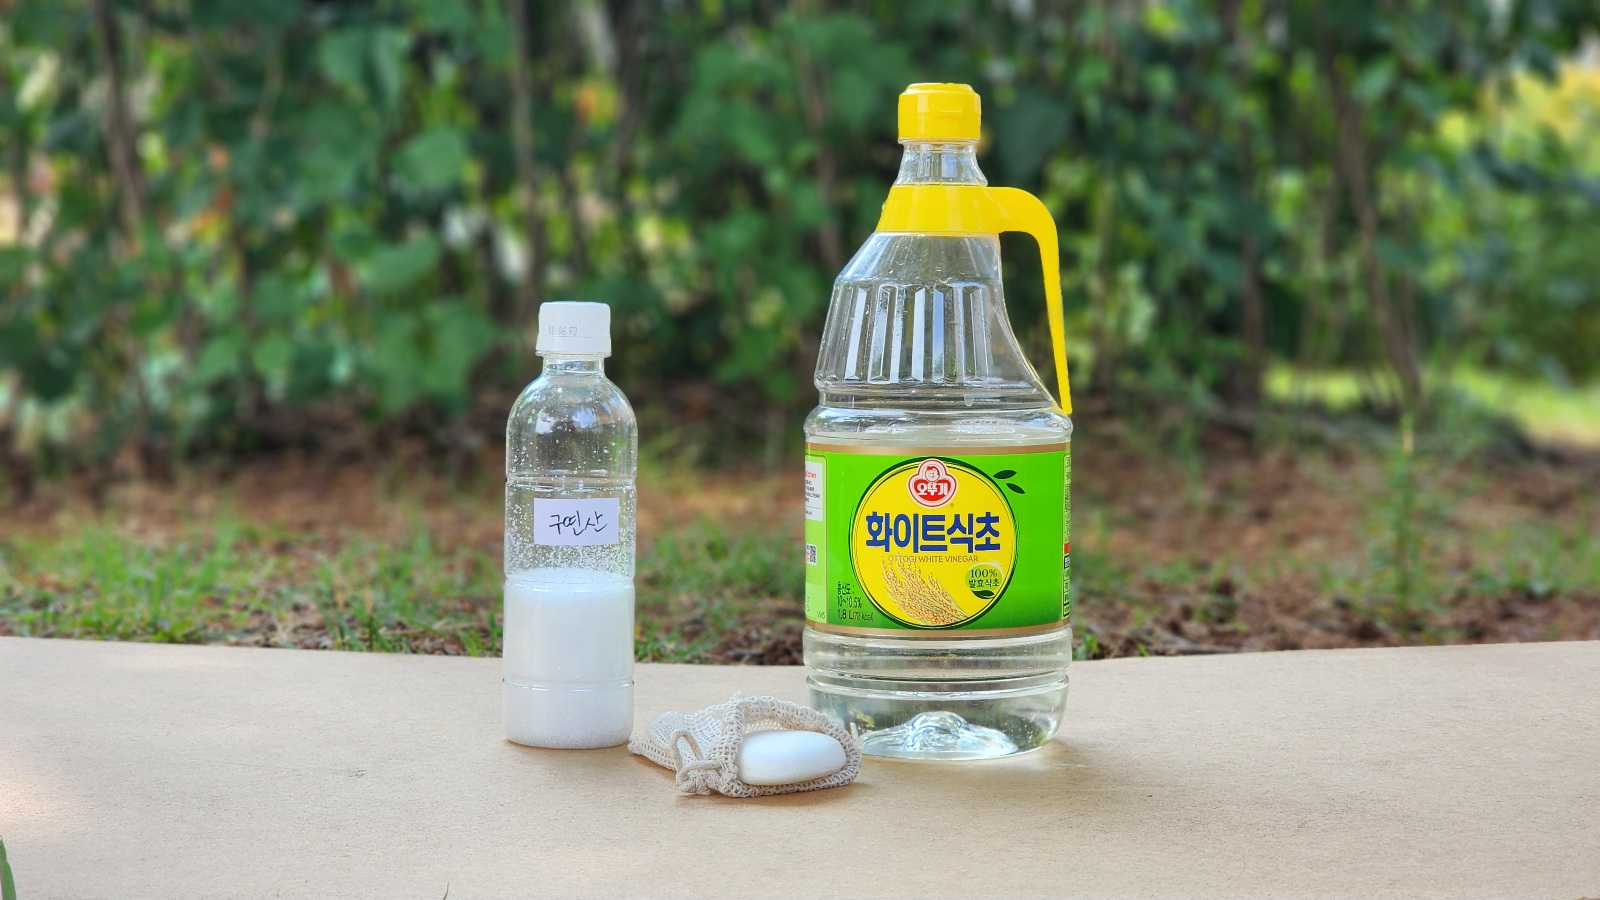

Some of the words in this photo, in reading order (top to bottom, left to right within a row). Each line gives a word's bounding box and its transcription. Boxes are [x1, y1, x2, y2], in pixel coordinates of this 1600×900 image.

[916, 482, 948, 496] 오뚜기
[548, 510, 608, 536] 구연산
[865, 511, 1001, 553] 화이트식초
[888, 555, 917, 563] OTTOGI
[970, 569, 998, 578] 100%
[968, 578, 1000, 588] 발효식초
